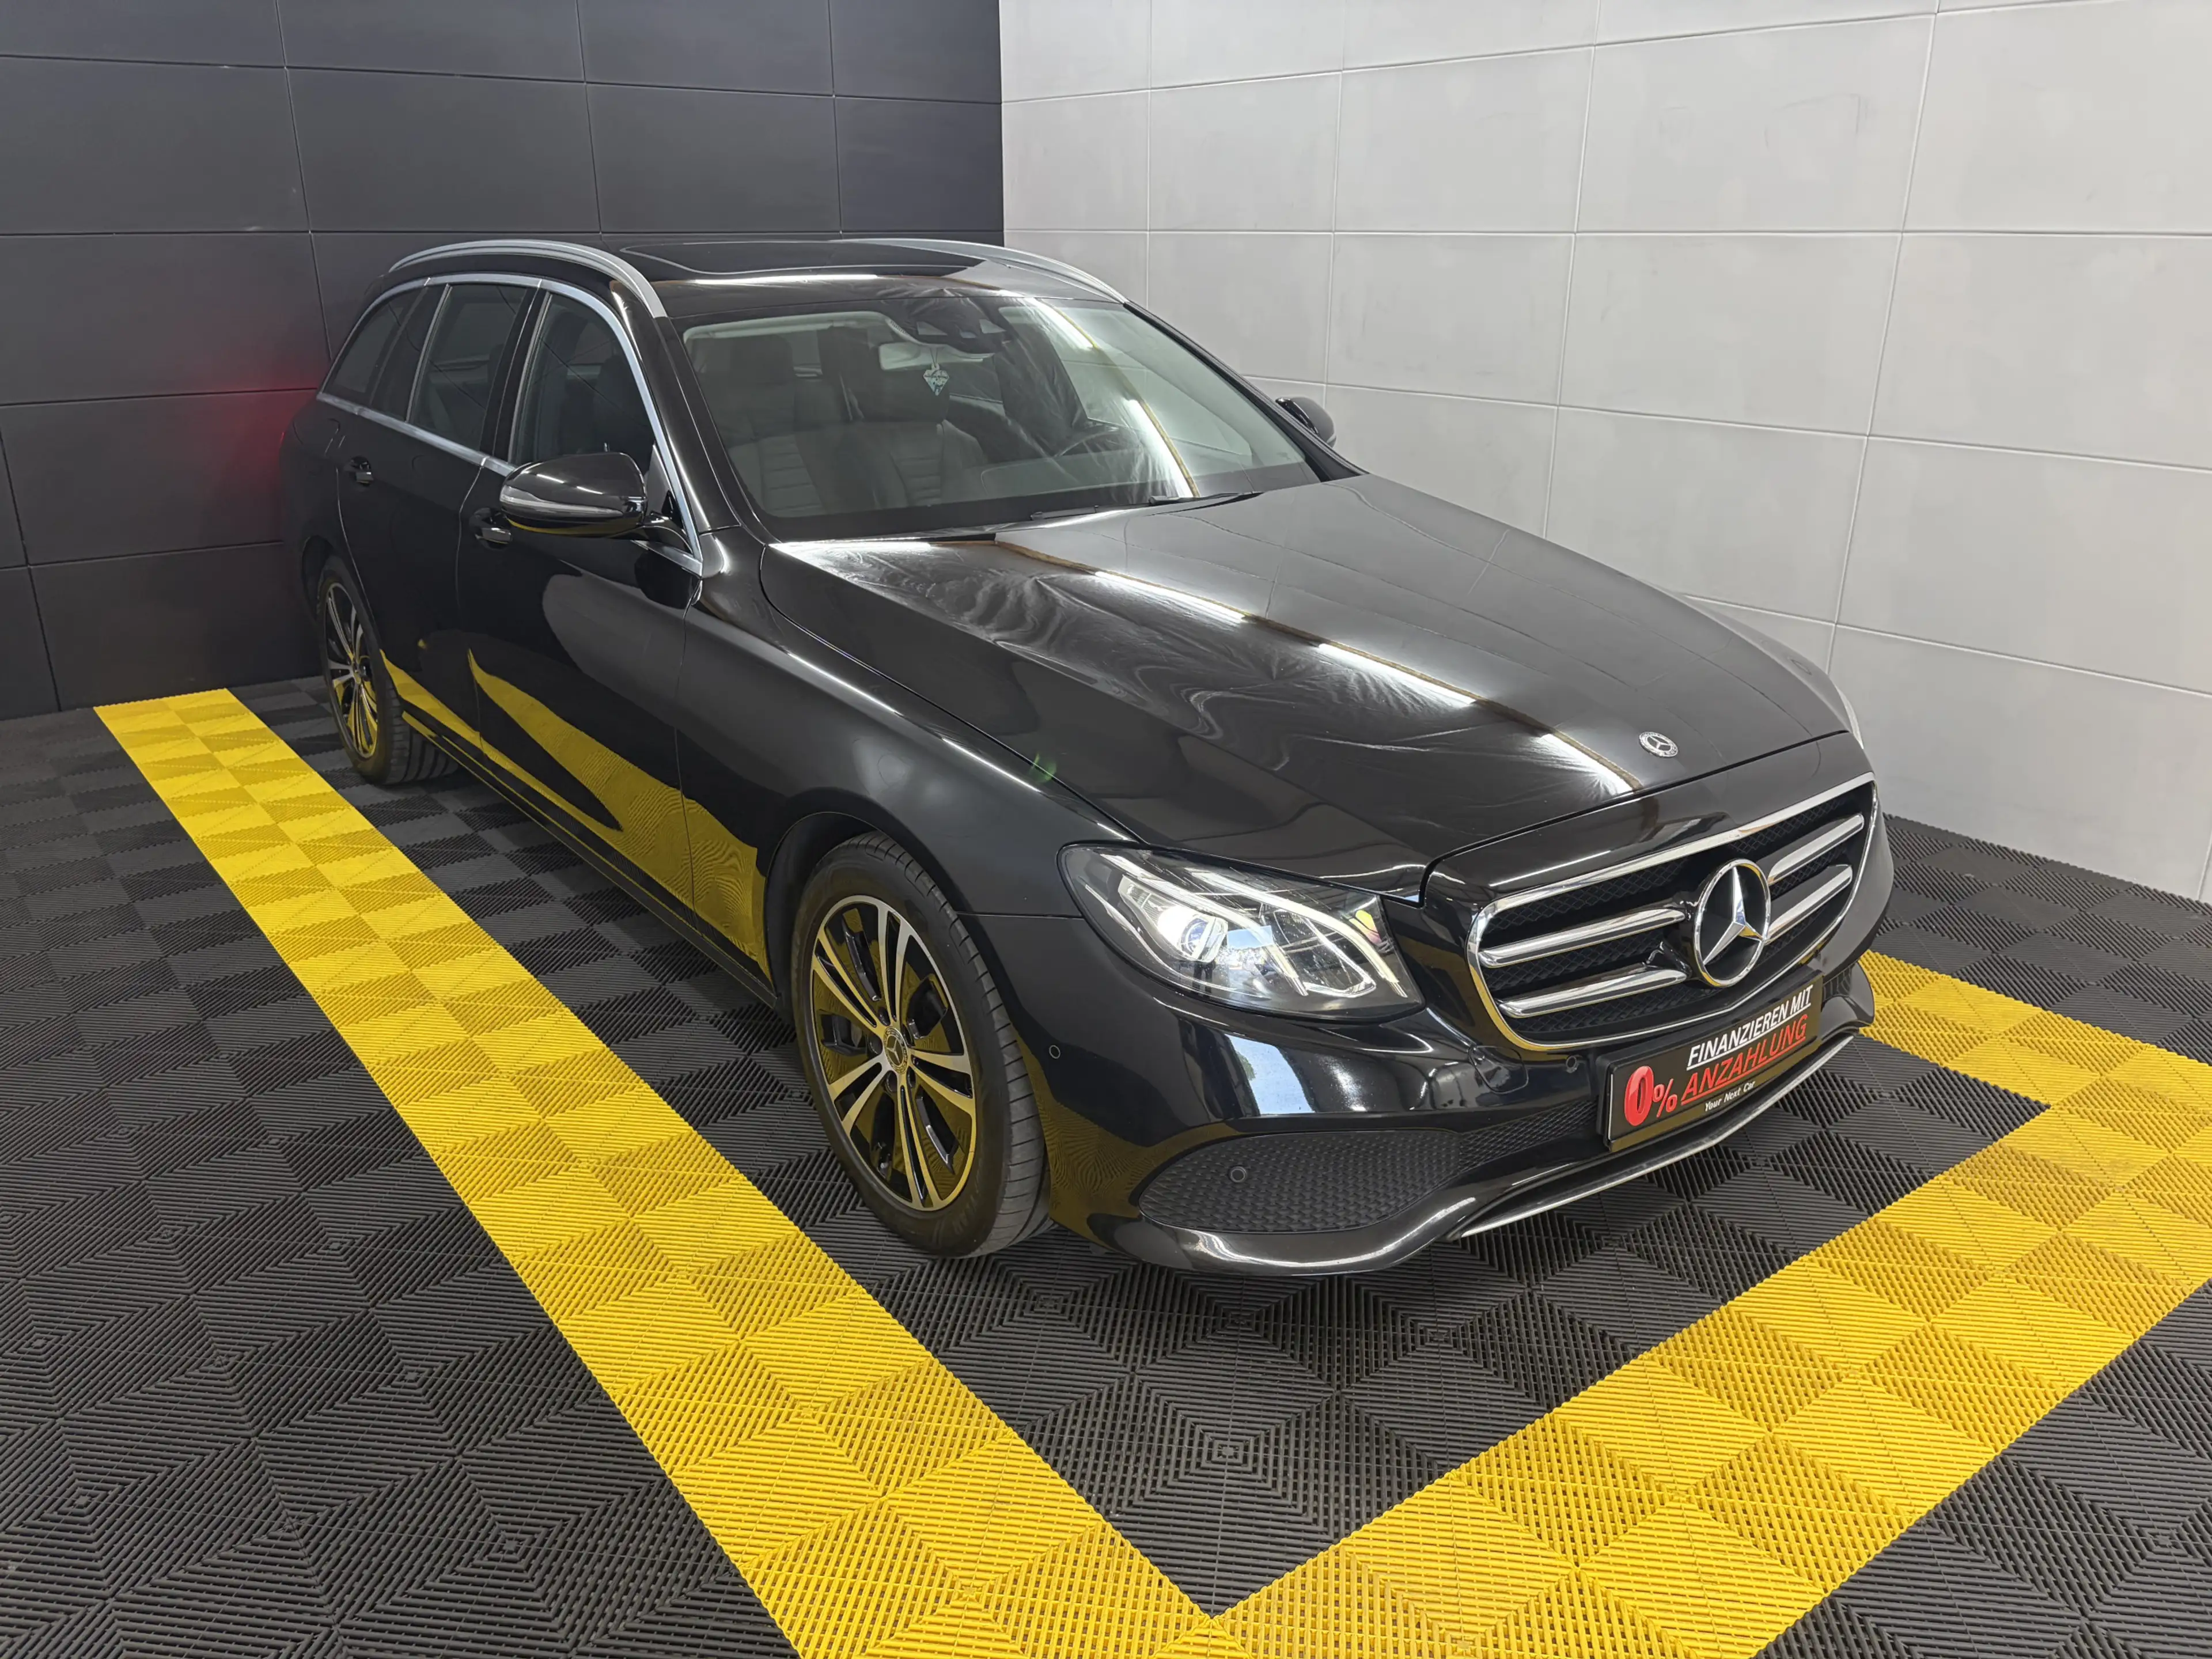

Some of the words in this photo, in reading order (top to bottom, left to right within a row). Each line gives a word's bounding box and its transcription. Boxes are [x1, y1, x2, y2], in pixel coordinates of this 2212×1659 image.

[1687, 999, 1790, 1069] FINANZIEREN
[1789, 984, 1814, 1014] MIT
[1624, 1065, 1678, 1127] 0%
[1680, 1014, 1808, 1104] ANZAHLUNG
[1705, 1098, 1722, 1112] Your
[1724, 1088, 1740, 1102] Next
[1743, 1081, 1756, 1092] Car
